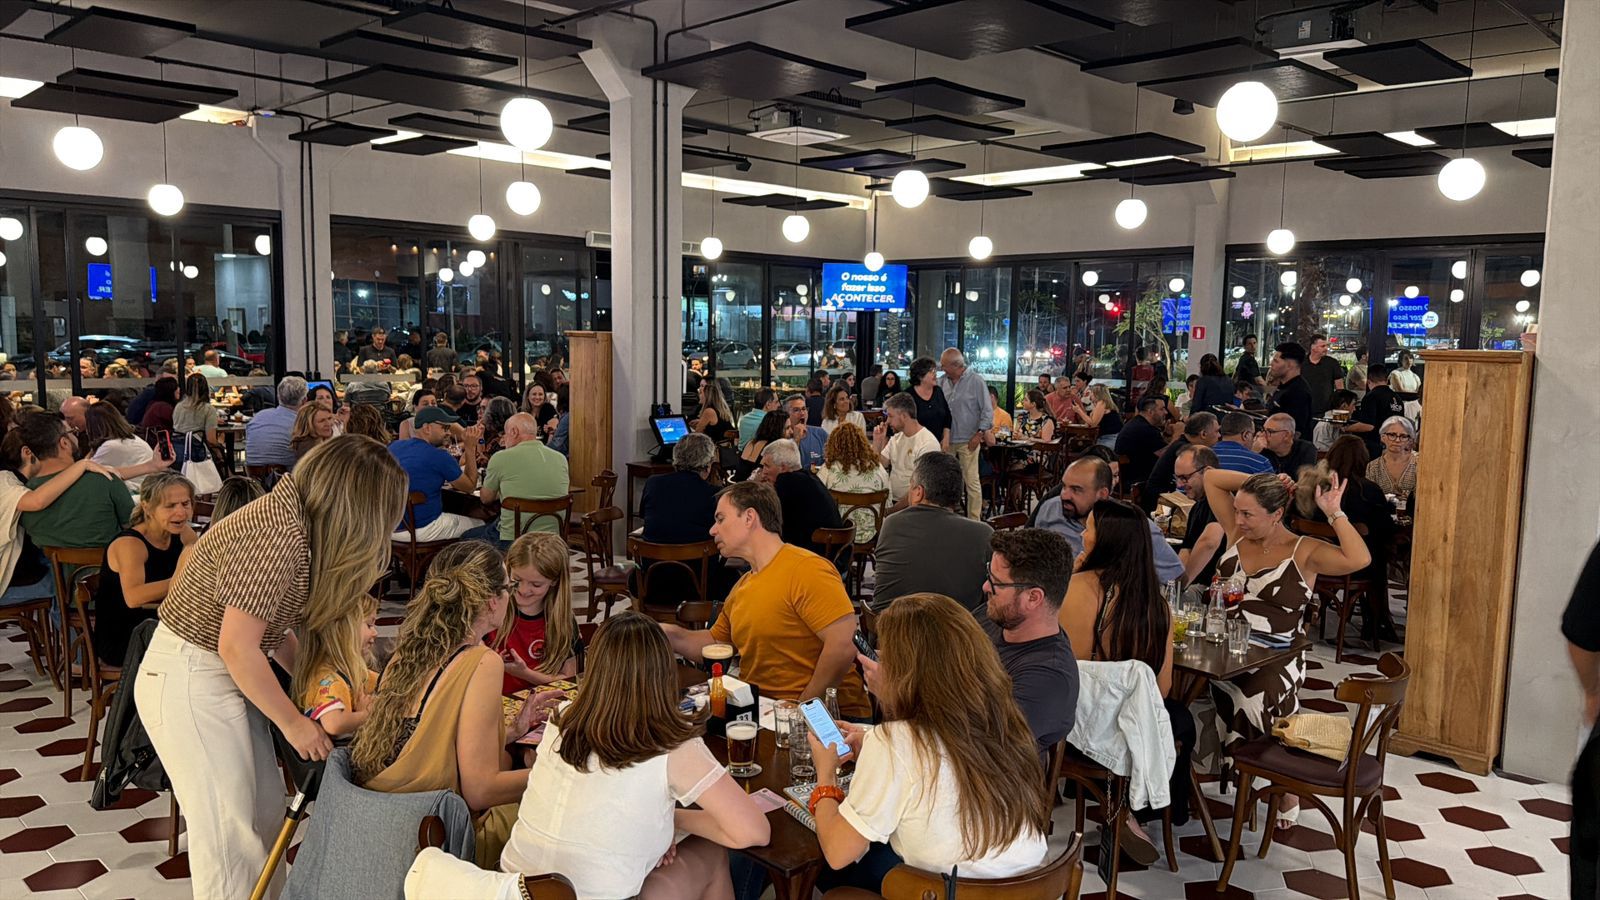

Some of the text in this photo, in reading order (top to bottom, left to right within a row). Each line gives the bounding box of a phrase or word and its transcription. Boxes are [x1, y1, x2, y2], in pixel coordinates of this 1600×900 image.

[841, 272, 888, 282] O nosso é
[841, 282, 886, 292] fazer isso
[831, 293, 895, 303] ACONTECER.
